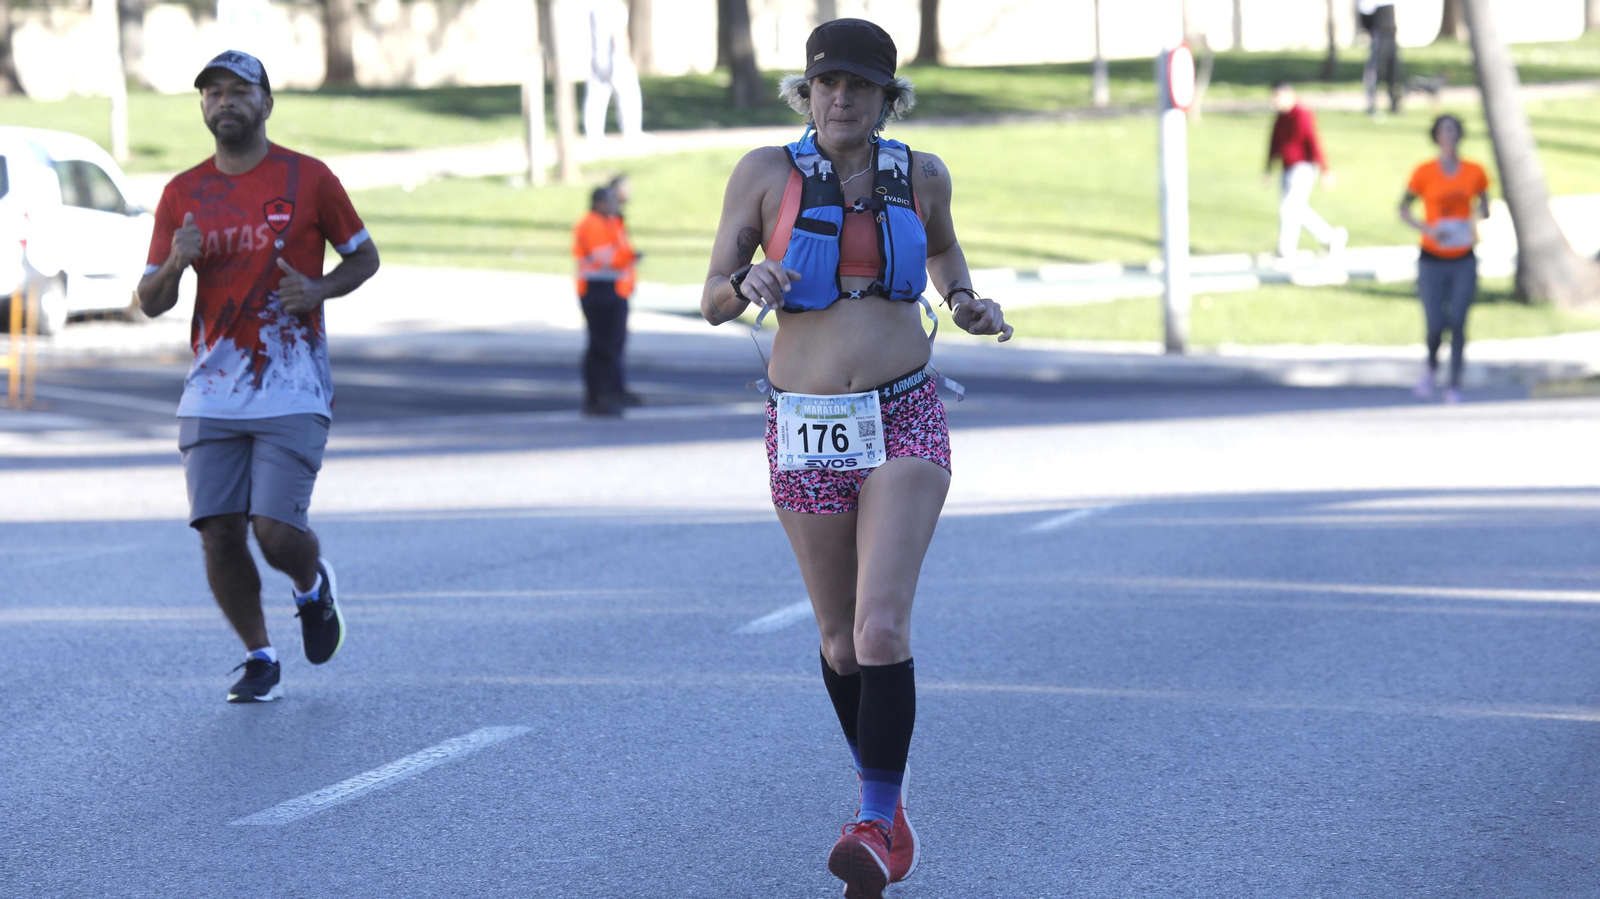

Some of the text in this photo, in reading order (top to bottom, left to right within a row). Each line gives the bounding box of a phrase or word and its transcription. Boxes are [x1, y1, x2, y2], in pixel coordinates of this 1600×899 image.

[884, 196, 910, 206] EVADICT
[893, 370, 924, 395] ARMOUR
[804, 404, 847, 414] MARATÓN
[798, 423, 849, 453] 176
[805, 458, 857, 468] EVOS
